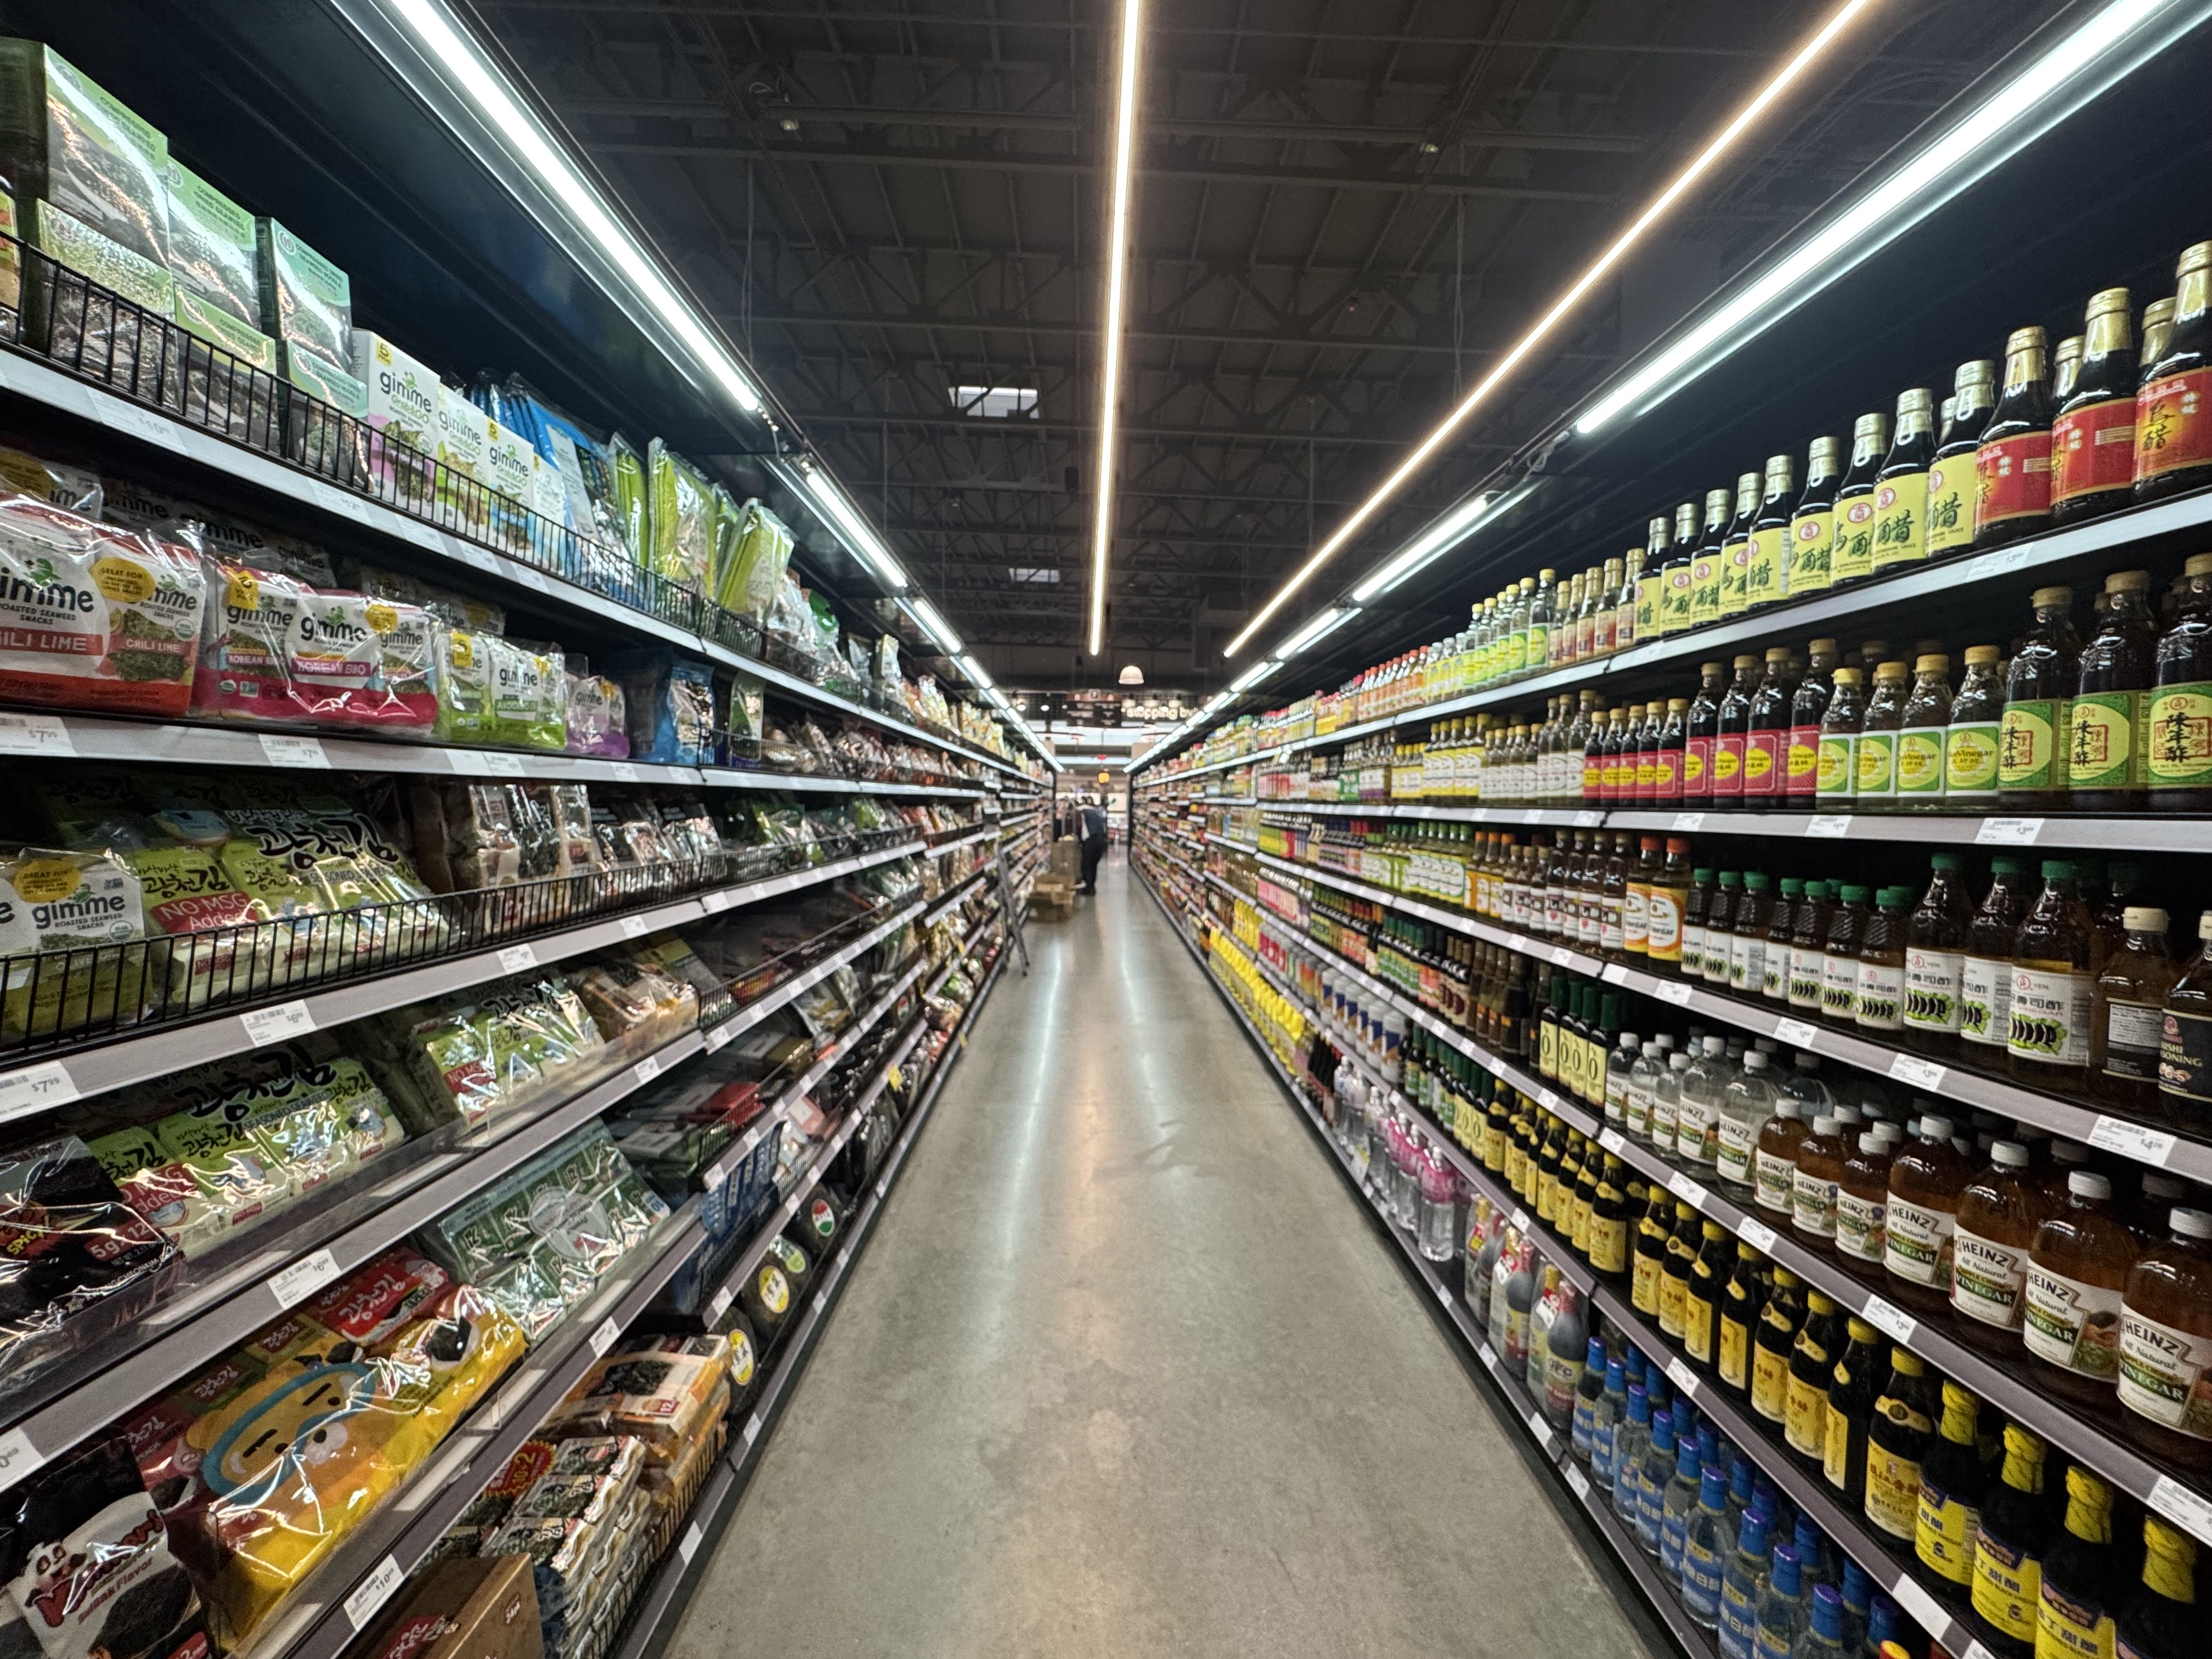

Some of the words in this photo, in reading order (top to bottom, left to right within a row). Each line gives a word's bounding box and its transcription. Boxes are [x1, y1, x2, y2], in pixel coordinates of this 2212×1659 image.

[380, 371, 432, 414] gimme
[439, 410, 482, 446] gimme
[489, 445, 529, 477] gimme
[0, 567, 95, 613] imme
[1, 605, 37, 615] OASTED
[19, 613, 54, 625] SNACKS
[227, 605, 294, 626] gimme
[0, 633, 31, 648] ILI
[40, 634, 88, 651] LIME
[126, 638, 155, 651] CHILI
[158, 641, 182, 653] LIME
[381, 631, 424, 648] gimme
[228, 654, 263, 665] KOREAN
[345, 663, 366, 675] BBQ
[242, 812, 400, 870] 광천김
[142, 866, 230, 898] 광천김
[31, 895, 126, 929] gimme
[159, 900, 200, 921] NO
[204, 893, 248, 914] MSG
[2160, 1049, 2204, 1068] SONING
[1797, 1180, 1822, 1195] HEINZ
[1839, 1199, 1865, 1215] HEINZ
[1891, 1205, 1931, 1229] HEINZ
[1900, 1224, 1930, 1242] Natural
[1962, 1240, 2009, 1268] HEINZ
[1973, 1262, 2008, 1280] Natural
[1956, 1272, 2013, 1304] VINEGAR
[2028, 1272, 2069, 1302] HEINZ
[2035, 1295, 2068, 1315] Natural
[2125, 1319, 2179, 1356] HEINZ
[2136, 1346, 2177, 1372] Natural
